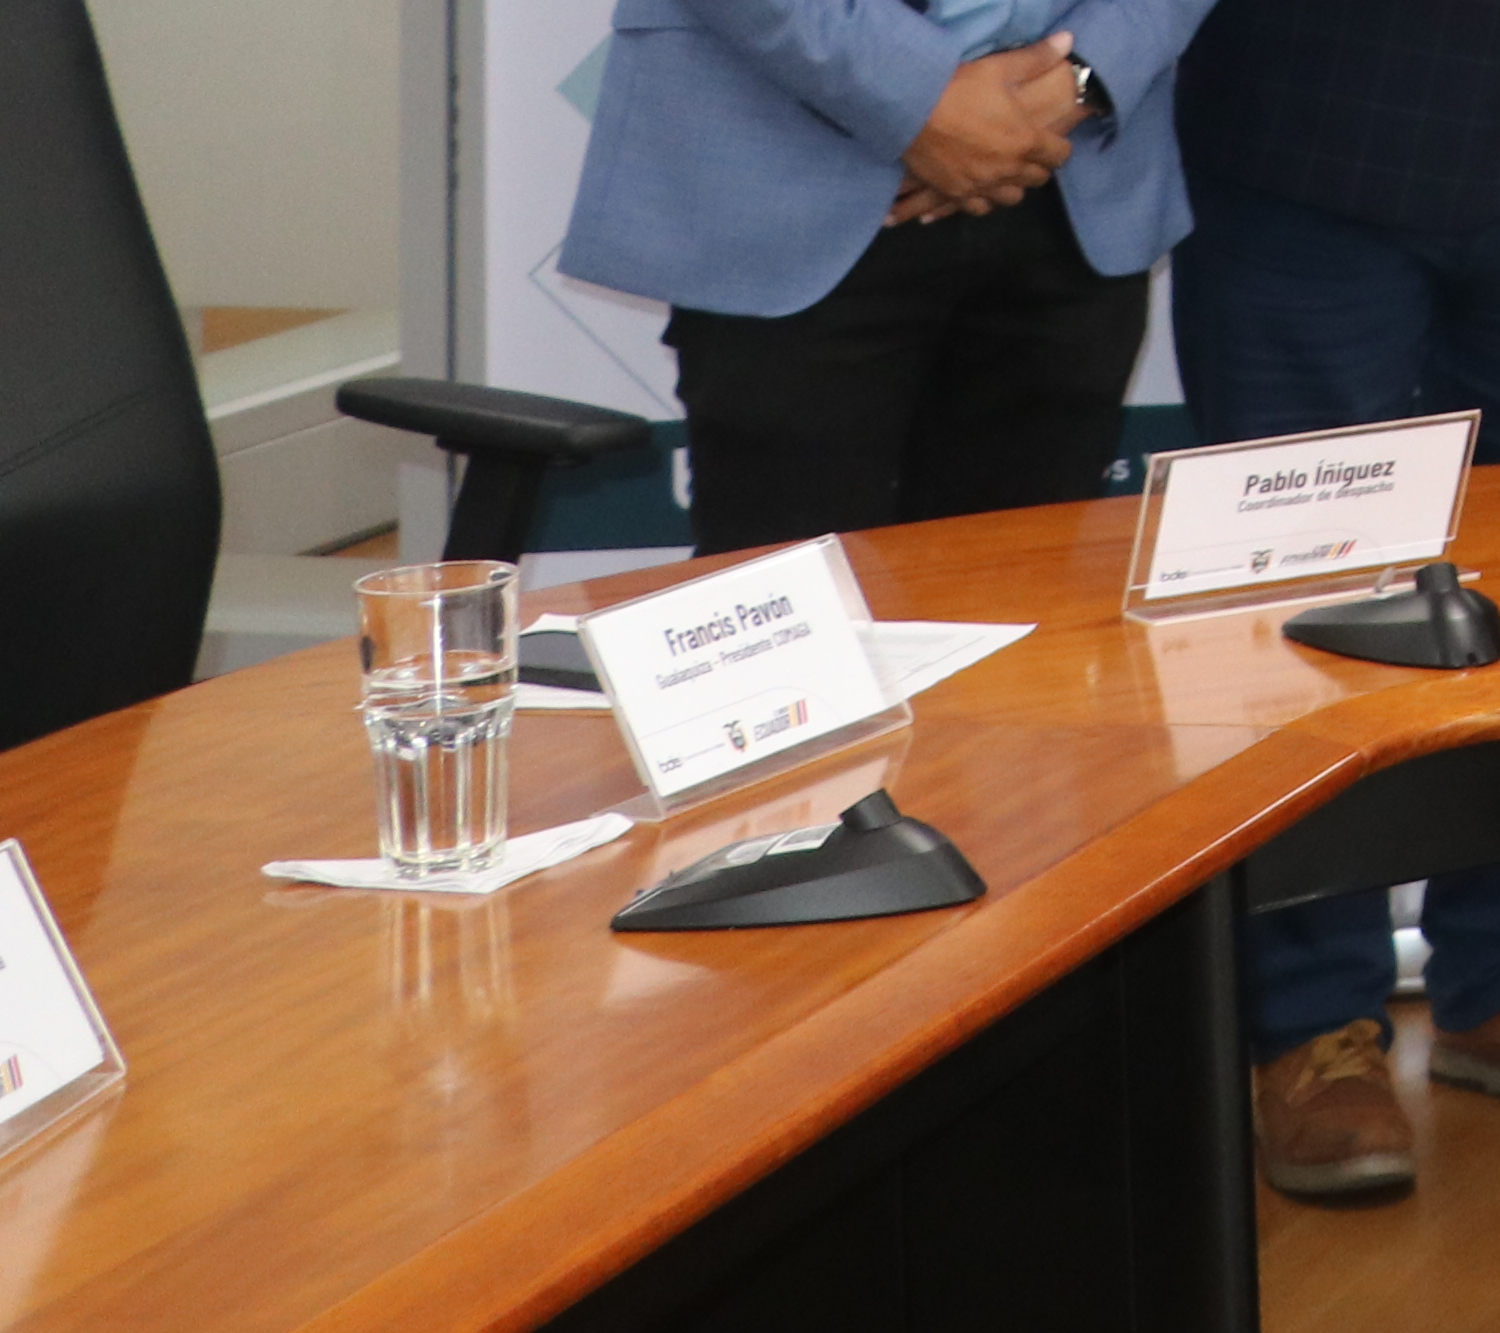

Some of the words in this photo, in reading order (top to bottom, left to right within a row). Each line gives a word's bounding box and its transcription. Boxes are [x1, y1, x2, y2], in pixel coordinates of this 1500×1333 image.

[1243, 469, 1308, 497] Pablo
[1313, 459, 1396, 492] Íñiguez
[664, 612, 736, 657] Francis
[735, 593, 794, 631] Pavón
[720, 638, 773, 667] Presidente
